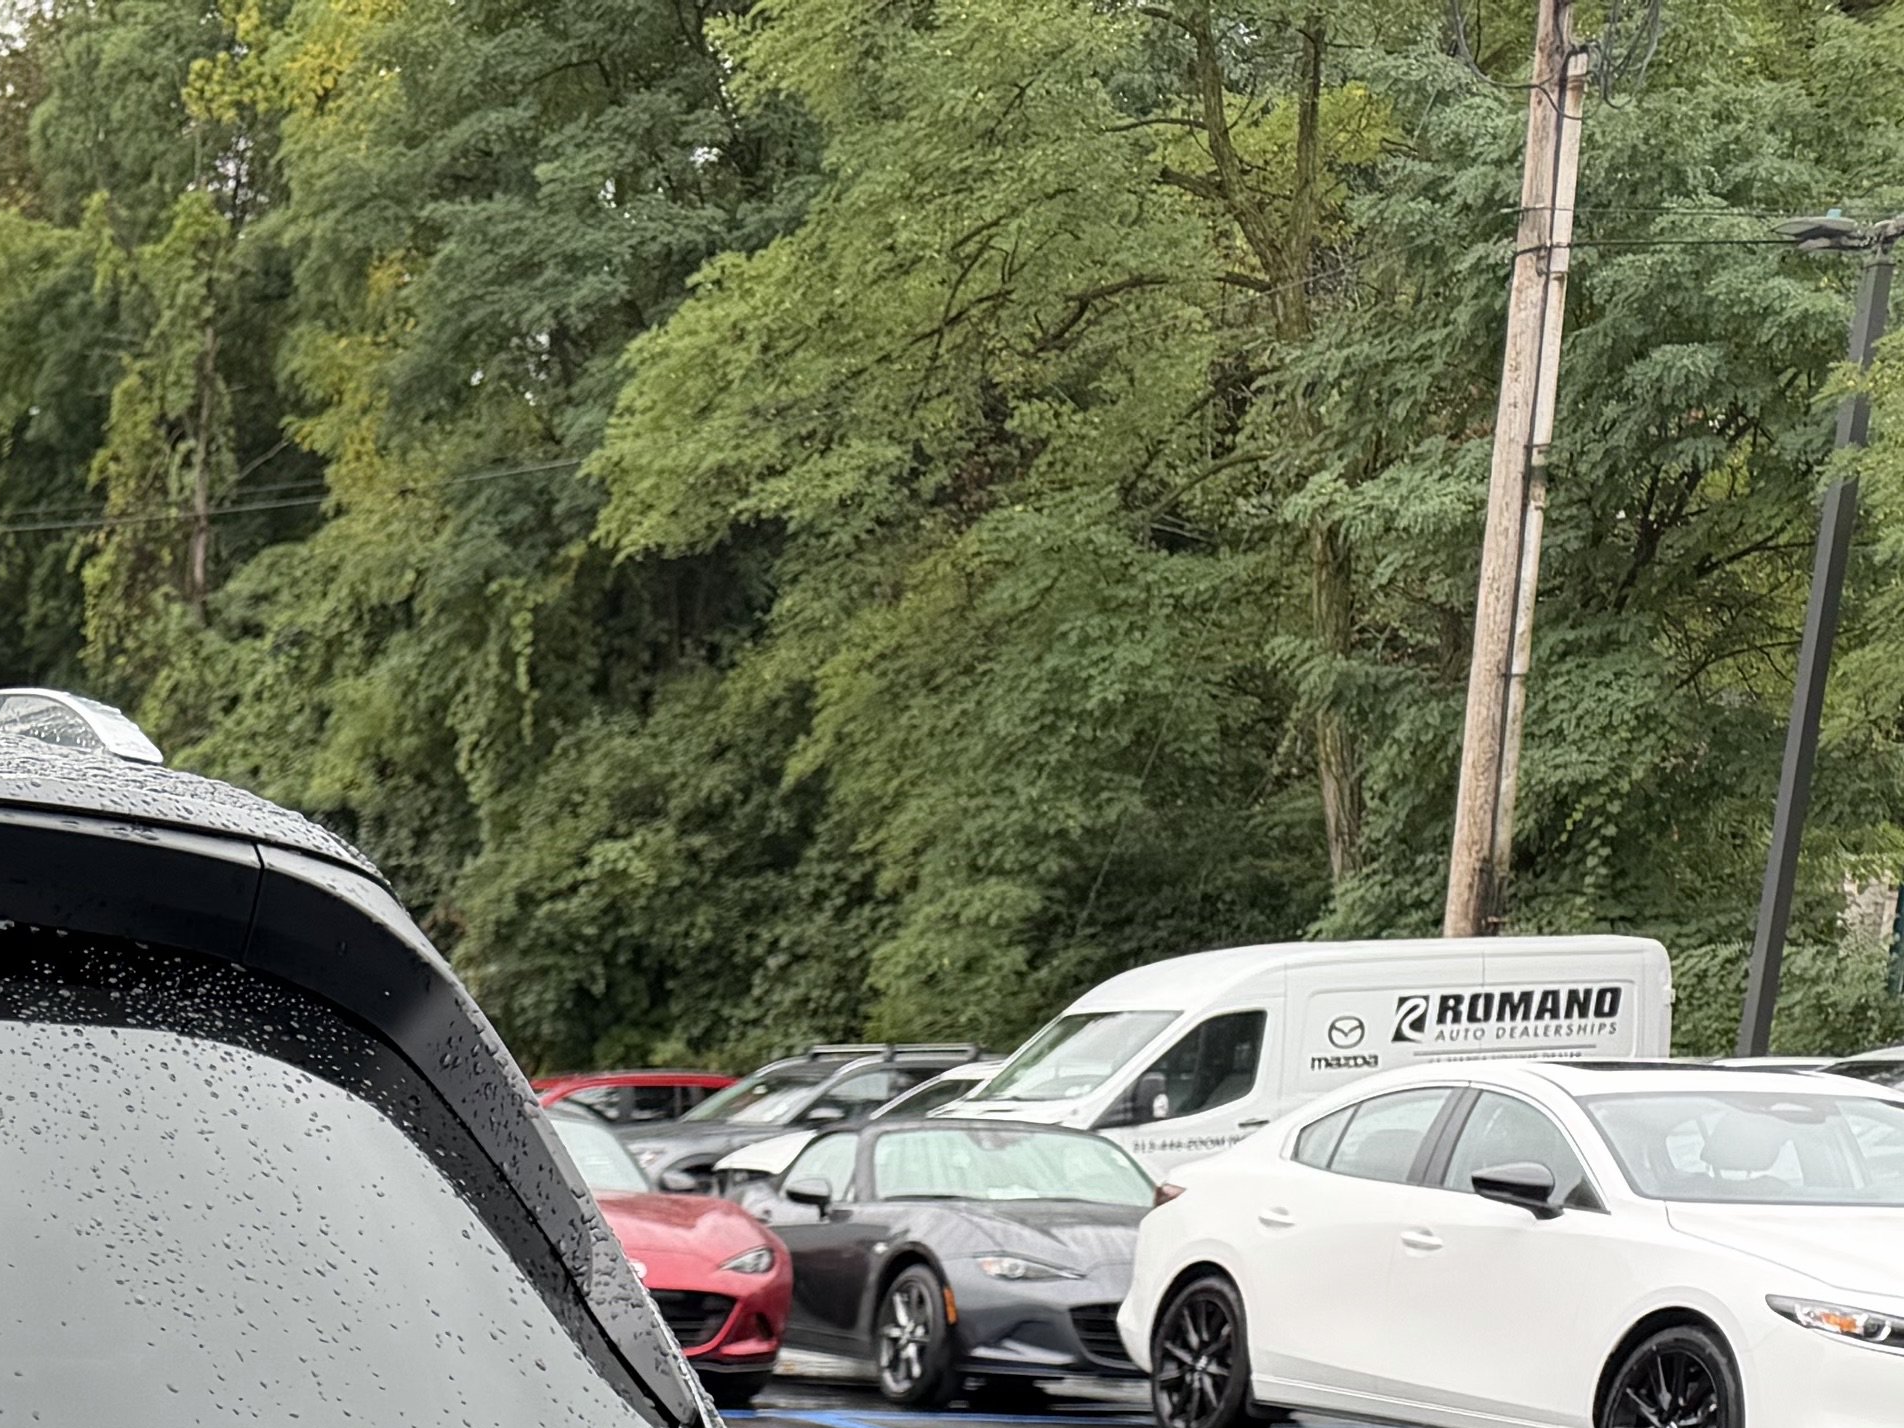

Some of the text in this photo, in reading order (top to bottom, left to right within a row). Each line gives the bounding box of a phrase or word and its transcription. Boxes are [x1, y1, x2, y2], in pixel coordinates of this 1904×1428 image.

[1436, 987, 1622, 1025] ROMANO
[1435, 1022, 1618, 1041] AUTO DEALERSHIPS
